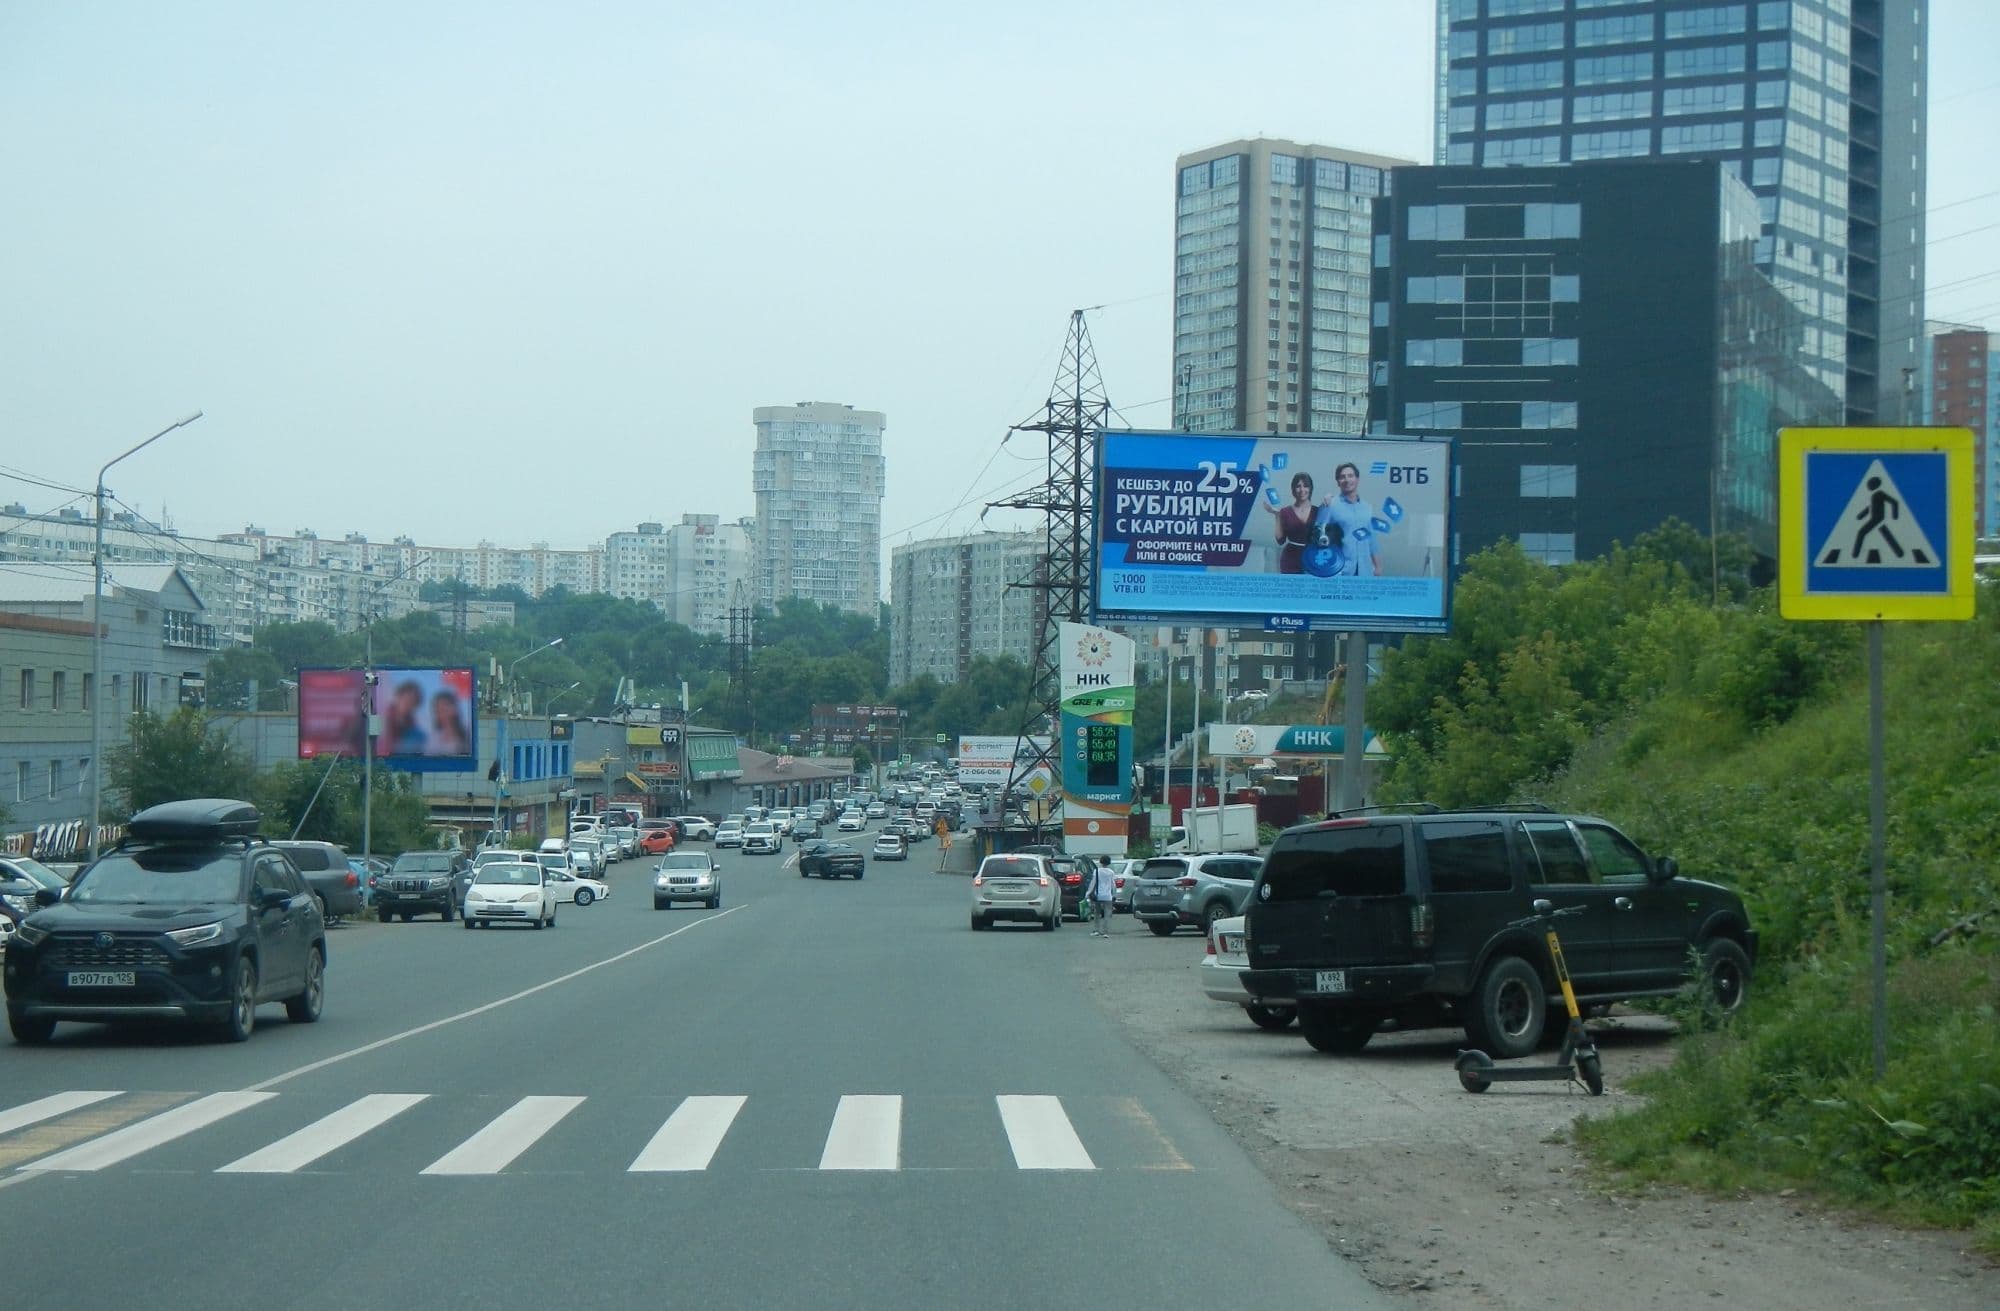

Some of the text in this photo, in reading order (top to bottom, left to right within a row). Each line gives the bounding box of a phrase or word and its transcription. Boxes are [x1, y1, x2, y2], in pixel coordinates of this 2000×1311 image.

[1390, 466, 1429, 484] ВТБ
[1117, 478, 1170, 491] КЕШБЭК
[1173, 480, 1193, 494] ДО
[1116, 494, 1232, 517] РУБЛЯМИ
[1116, 518, 1233, 536] С КАРТОЙ ВТБ
[1136, 540, 1244, 553] ОФОРМИТЕ НА VTB.RU
[1136, 551, 1202, 562] ИЛИ В ОФИСЕ
[1122, 574, 1146, 584] 1000
[1113, 584, 1146, 594] VTB.RU
[1281, 617, 1304, 626] Russ
[1076, 673, 1111, 685] ННК
[1294, 731, 1332, 746] ННК
[1087, 793, 1121, 802] маркет
[71, 972, 134, 985] В907ТВ 125
